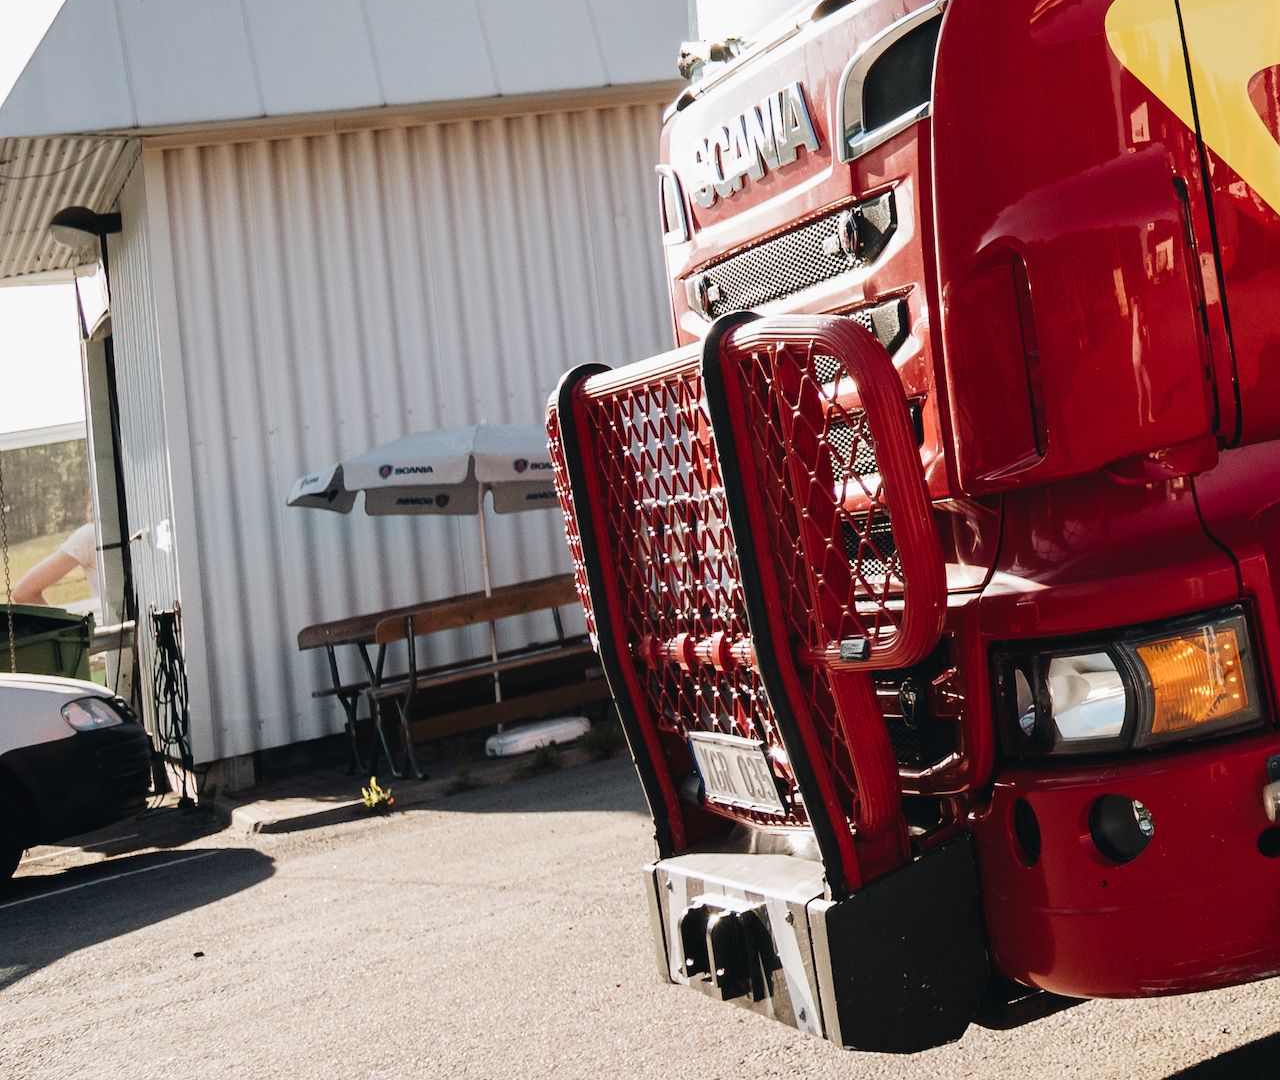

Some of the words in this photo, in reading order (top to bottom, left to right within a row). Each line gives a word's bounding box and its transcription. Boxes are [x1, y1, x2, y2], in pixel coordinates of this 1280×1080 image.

[690, 81, 820, 209] SCANIA
[395, 466, 433, 475] SCANIA
[699, 747, 738, 795] XGR
[736, 754, 777, 802] 035
